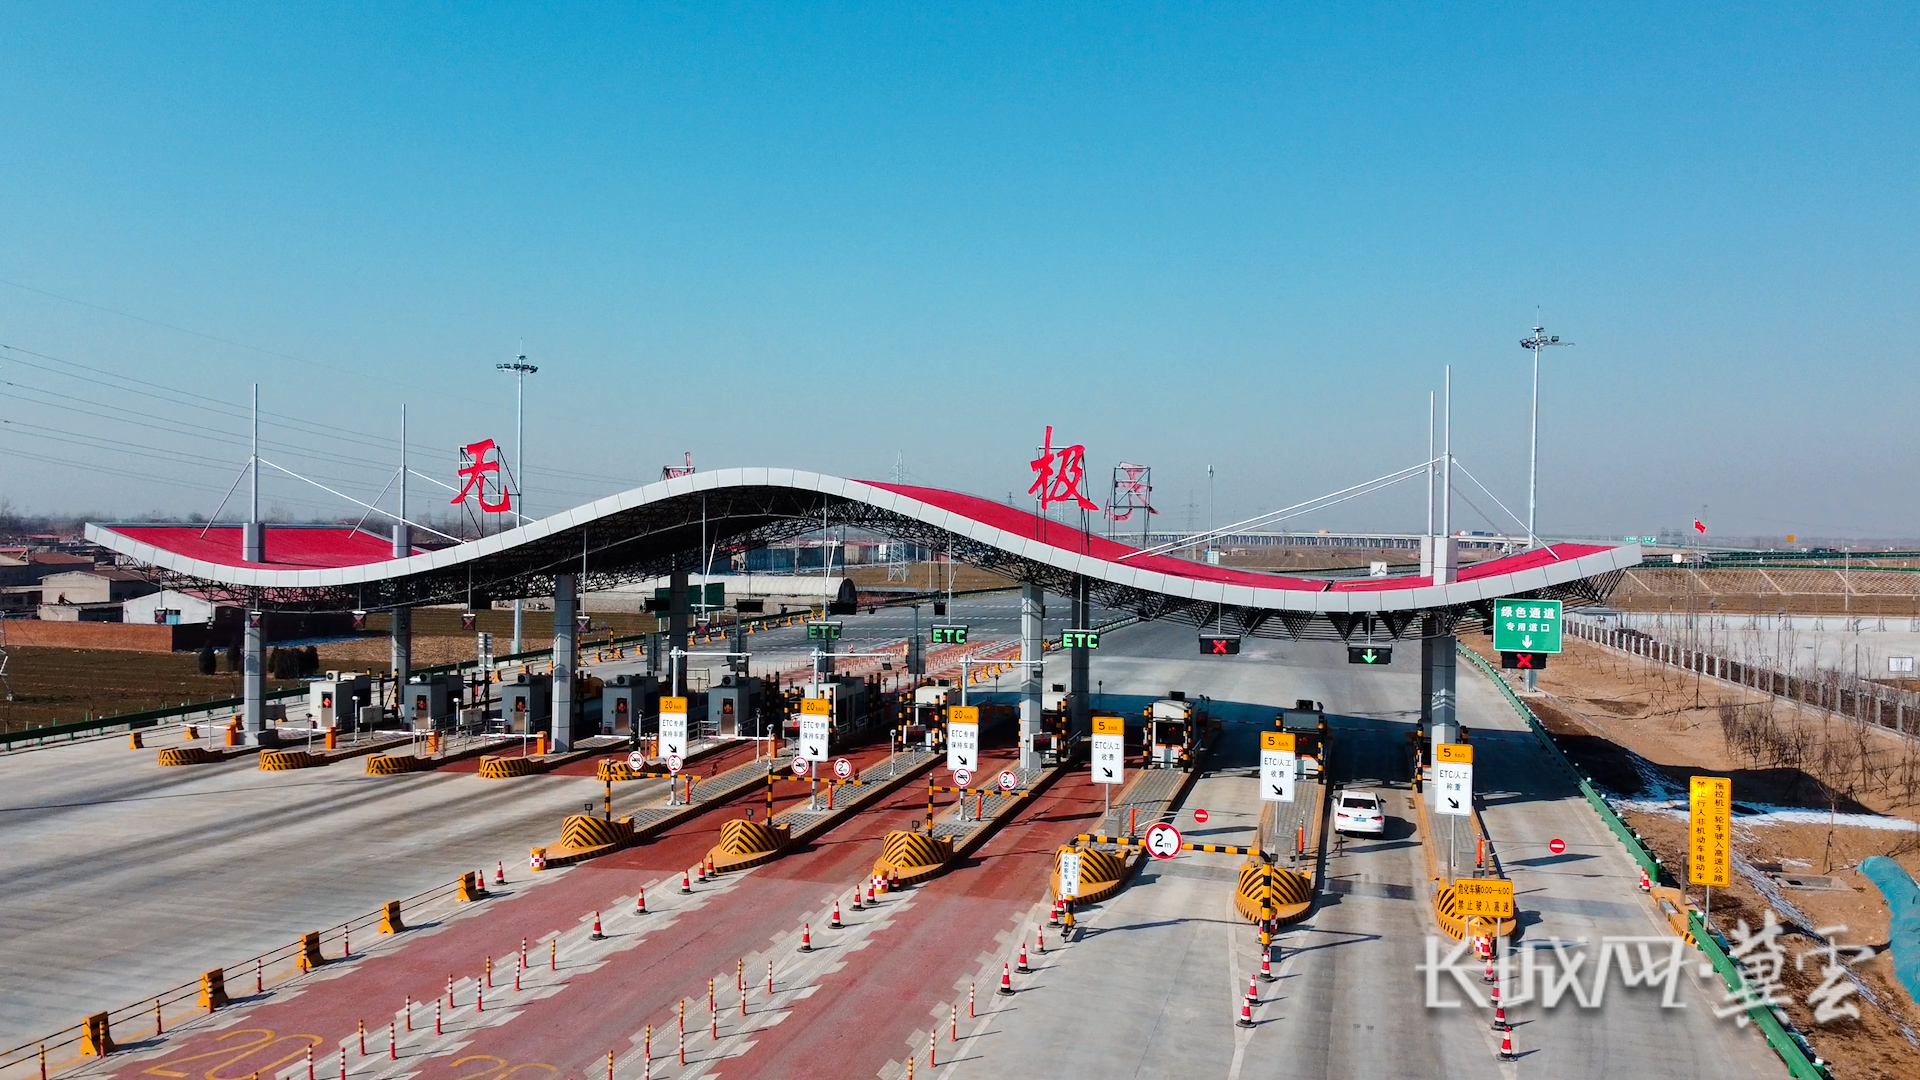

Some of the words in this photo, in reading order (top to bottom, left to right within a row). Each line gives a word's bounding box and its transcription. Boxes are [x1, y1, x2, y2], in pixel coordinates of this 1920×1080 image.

[450, 438, 511, 513] 无
[1500, 606, 1555, 619] 绿色通道
[808, 626, 839, 639] ETC
[1506, 622, 1550, 632] 专用道口
[932, 629, 966, 643] ETC
[1062, 633, 1098, 648] ETC
[664, 701, 673, 709] 20
[806, 702, 815, 711] 20
[954, 710, 963, 719] 20
[1098, 721, 1106, 731] 5
[1268, 736, 1276, 746] 5
[1443, 747, 1452, 758] 5
[1714, 782, 1725, 882] 拖拉机三轮车驶入高速公路
[1155, 833, 1172, 848] 2m
[1458, 899, 1510, 913] 禁止驶入高速
